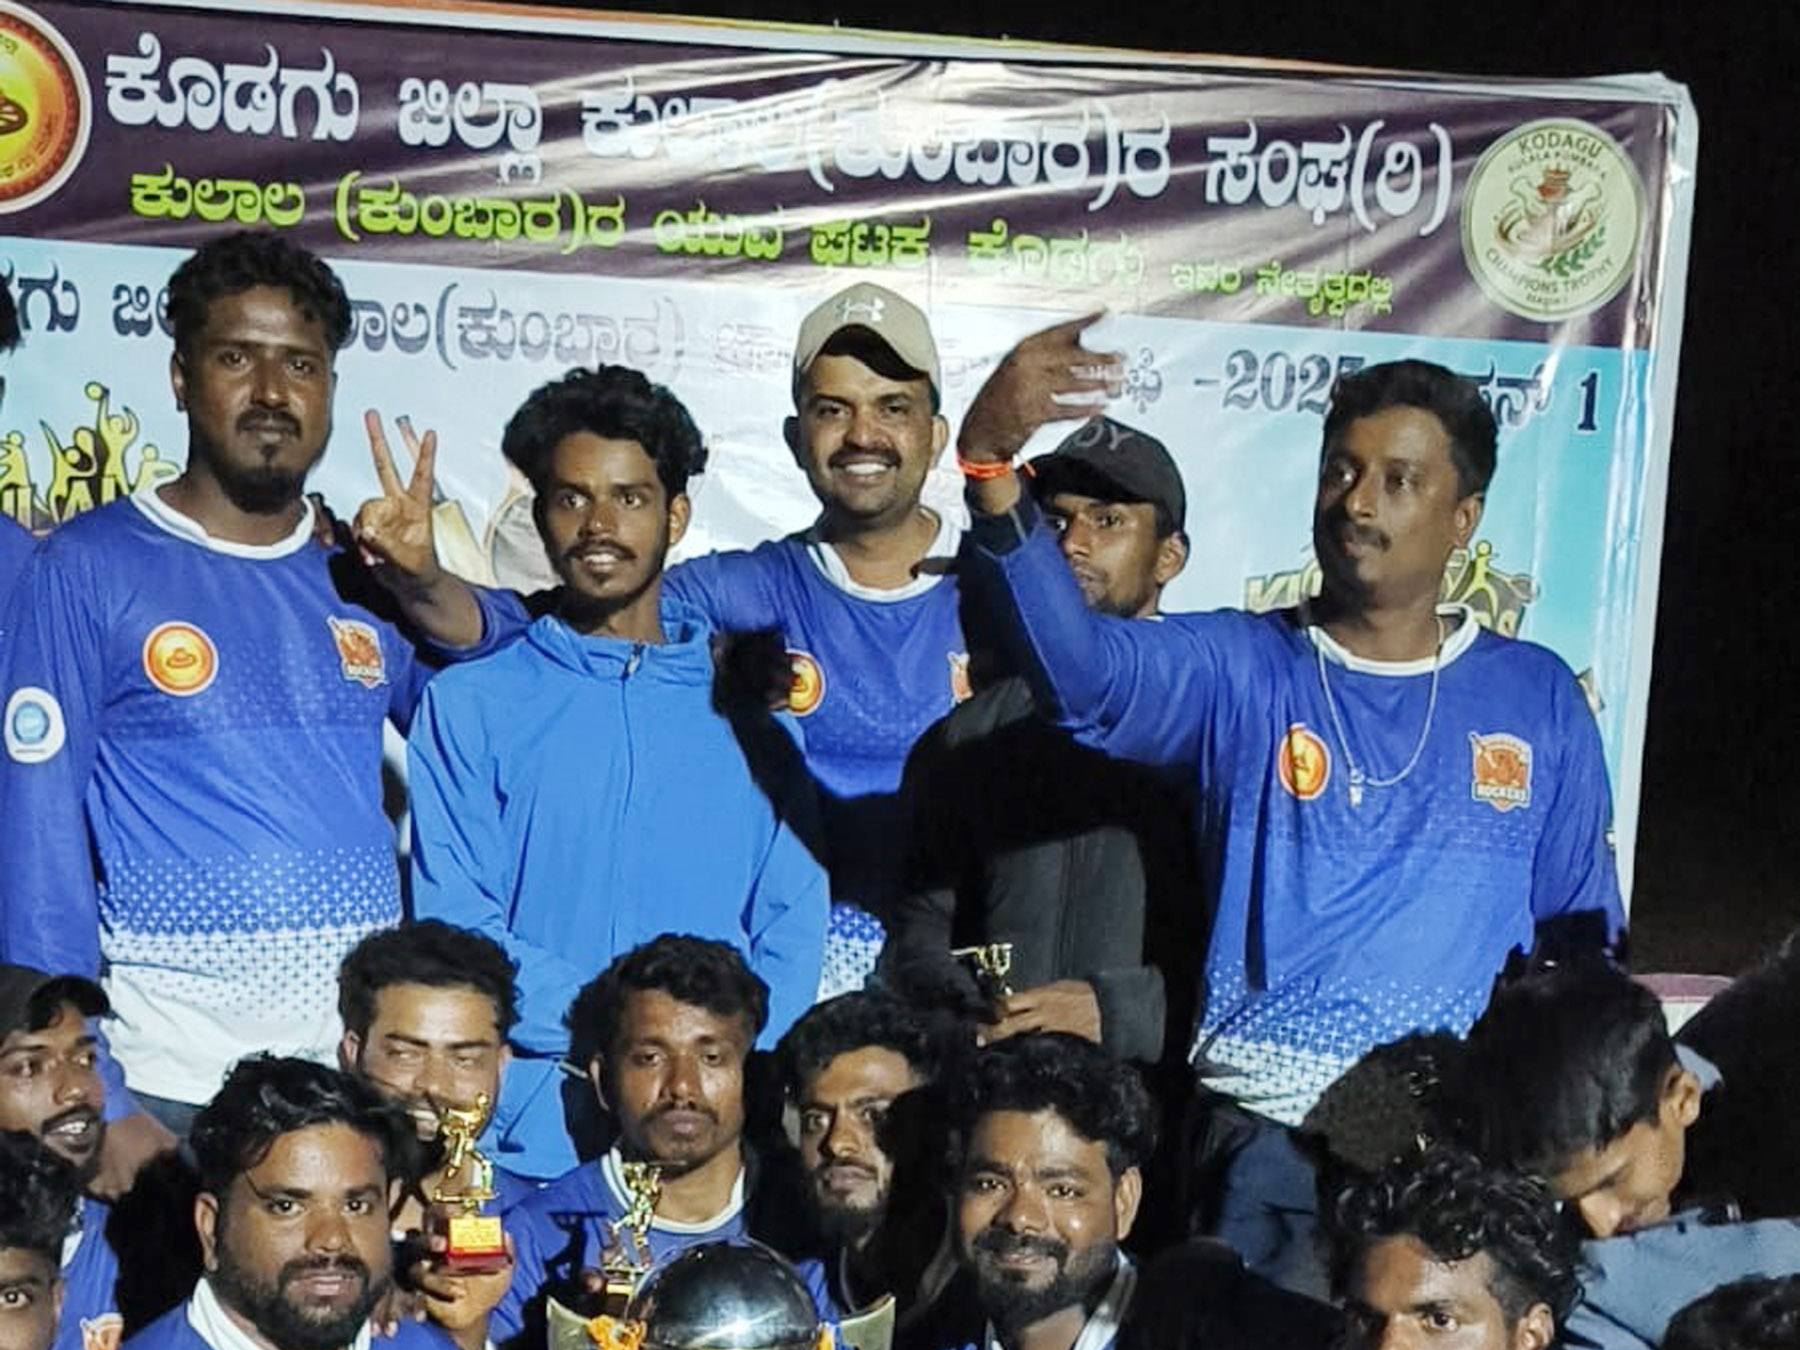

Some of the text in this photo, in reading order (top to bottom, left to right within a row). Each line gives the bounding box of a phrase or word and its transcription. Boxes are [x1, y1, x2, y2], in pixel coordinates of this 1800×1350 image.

[105, 31, 360, 142] ಕೊಡಗು
[399, 76, 543, 186] ಜಿಲ್ಲಾ
[1205, 118, 1452, 237] ಸಂಘ(ರಿ)
[1518, 132, 1603, 159] KODAGU
[130, 163, 306, 227] ಕುಲಾಲ
[335, 170, 626, 256] (ಕುಂಬಾರ)ರ
[655, 200, 784, 261] ಯುವ
[1564, 256, 1615, 294] TROPHY
[1578, 372, 1597, 431] 1
